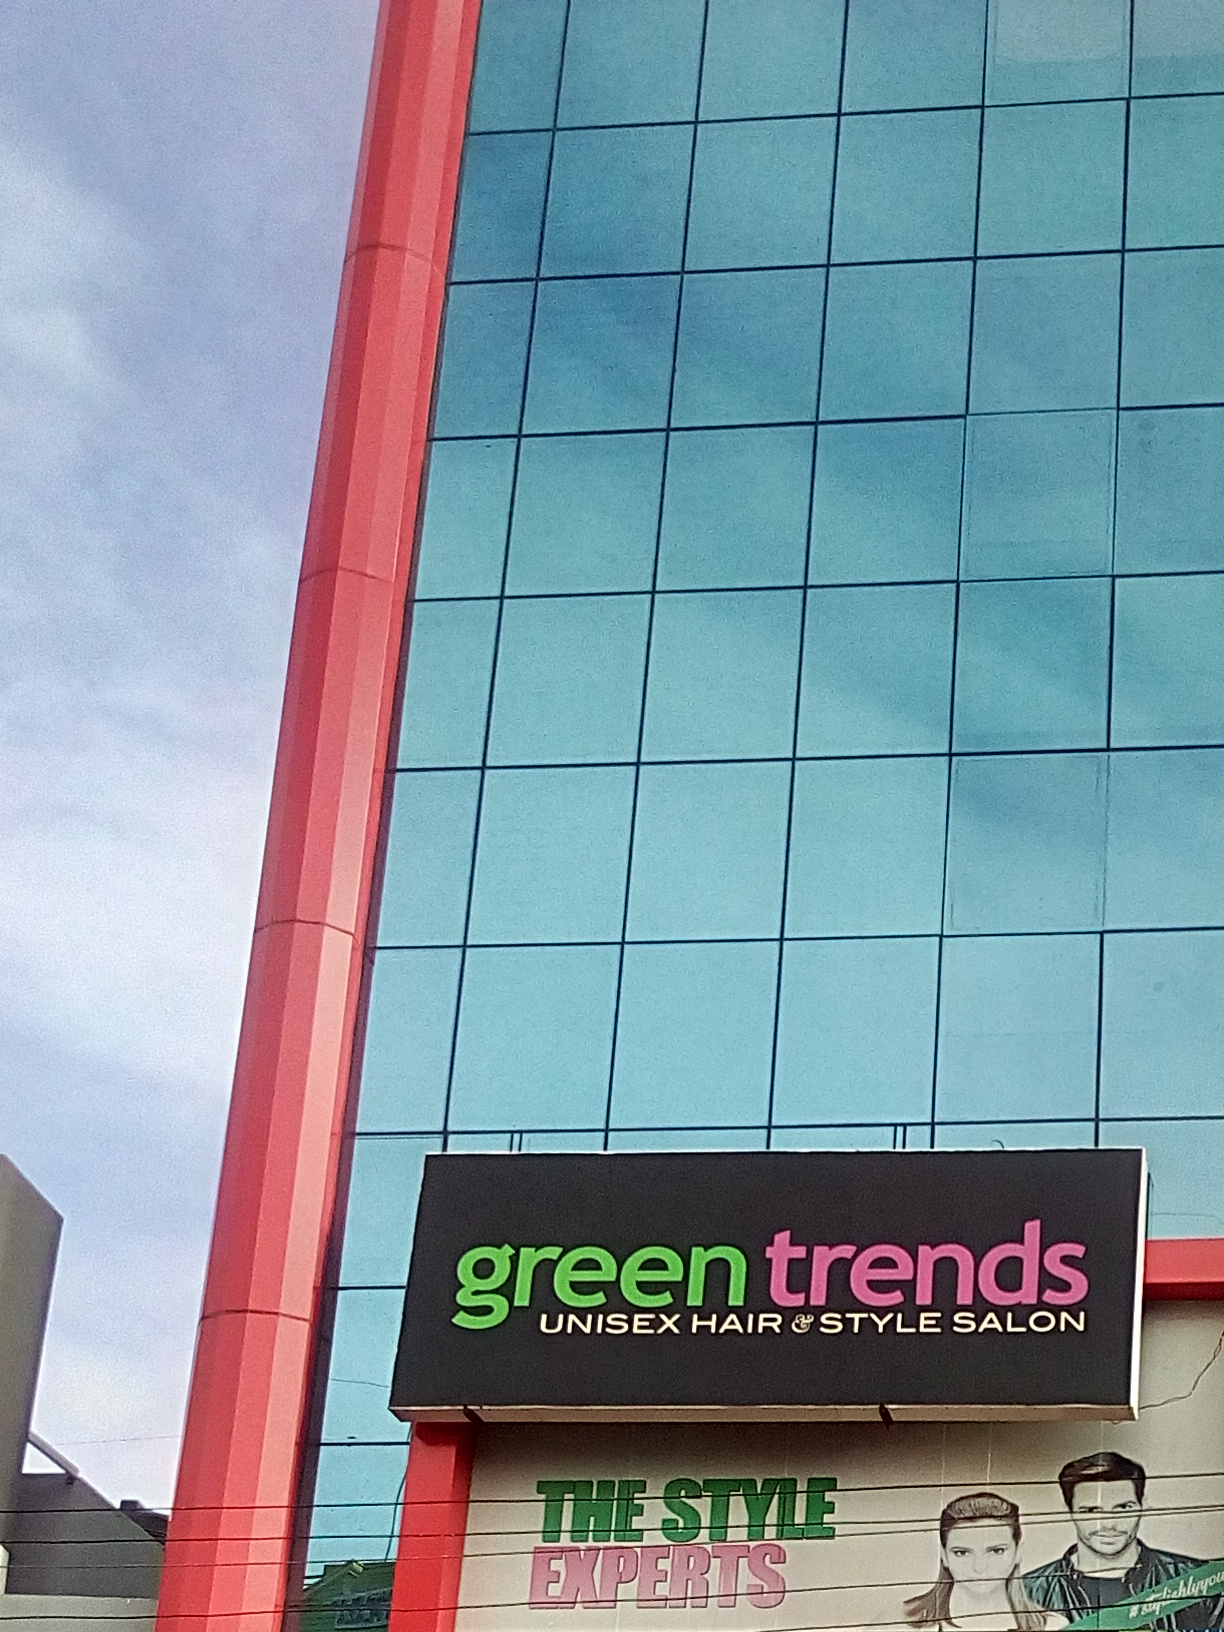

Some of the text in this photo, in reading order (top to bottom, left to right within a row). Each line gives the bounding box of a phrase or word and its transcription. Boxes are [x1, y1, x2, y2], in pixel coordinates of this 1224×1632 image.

[451, 1219, 1090, 1330] green trends
[540, 1311, 1086, 1335] UNISEX HAIR & STYLE SALON
[535, 1477, 838, 1543] THE STYLE
[528, 1543, 786, 1610] EXPERTS
